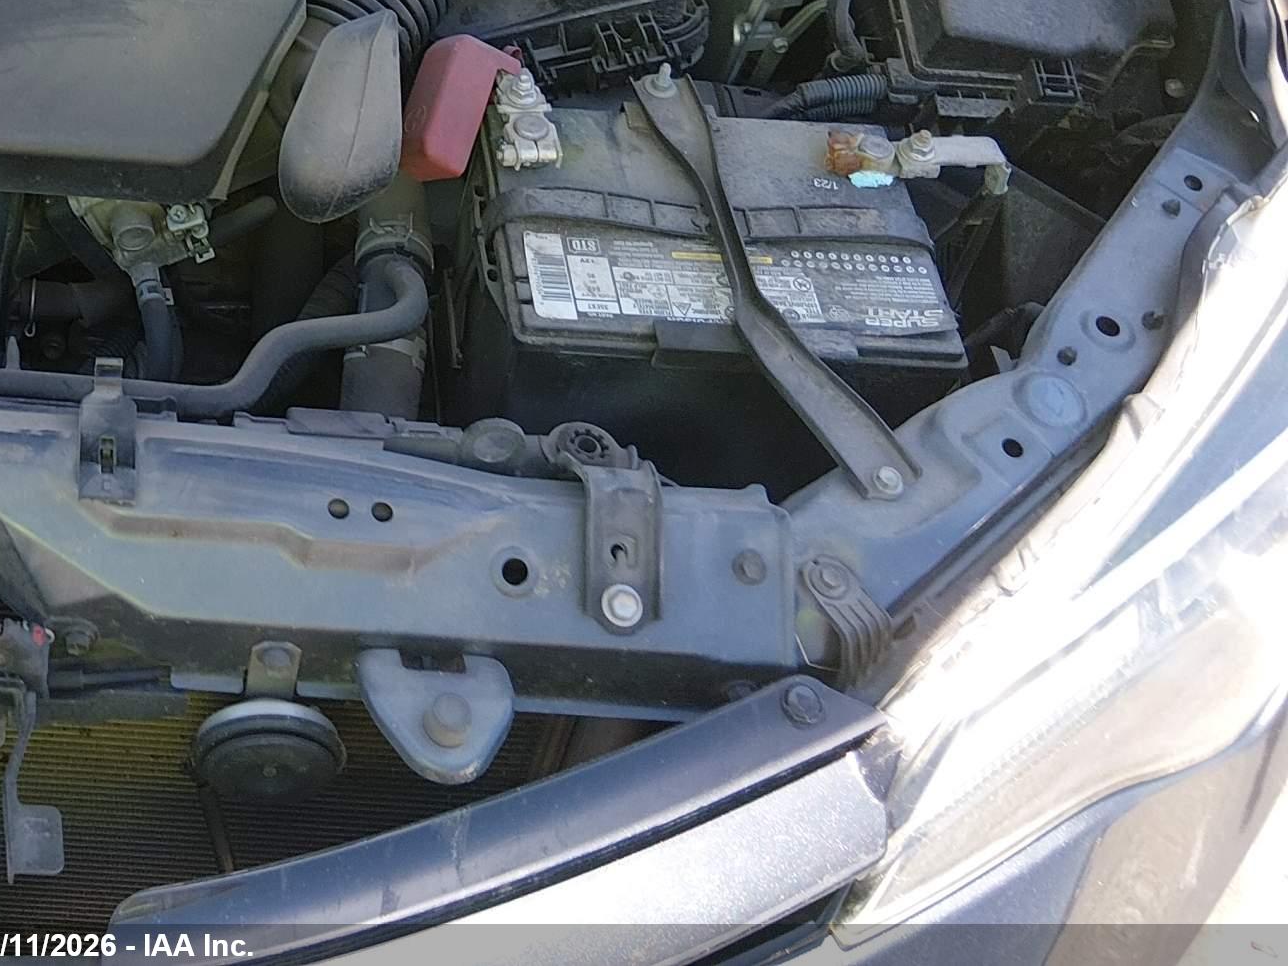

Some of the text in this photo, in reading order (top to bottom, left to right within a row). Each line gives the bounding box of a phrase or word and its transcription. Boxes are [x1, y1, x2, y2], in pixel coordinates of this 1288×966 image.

[813, 177, 839, 191] 1/23
[866, 306, 944, 321] START
[865, 315, 940, 329] SUPER
